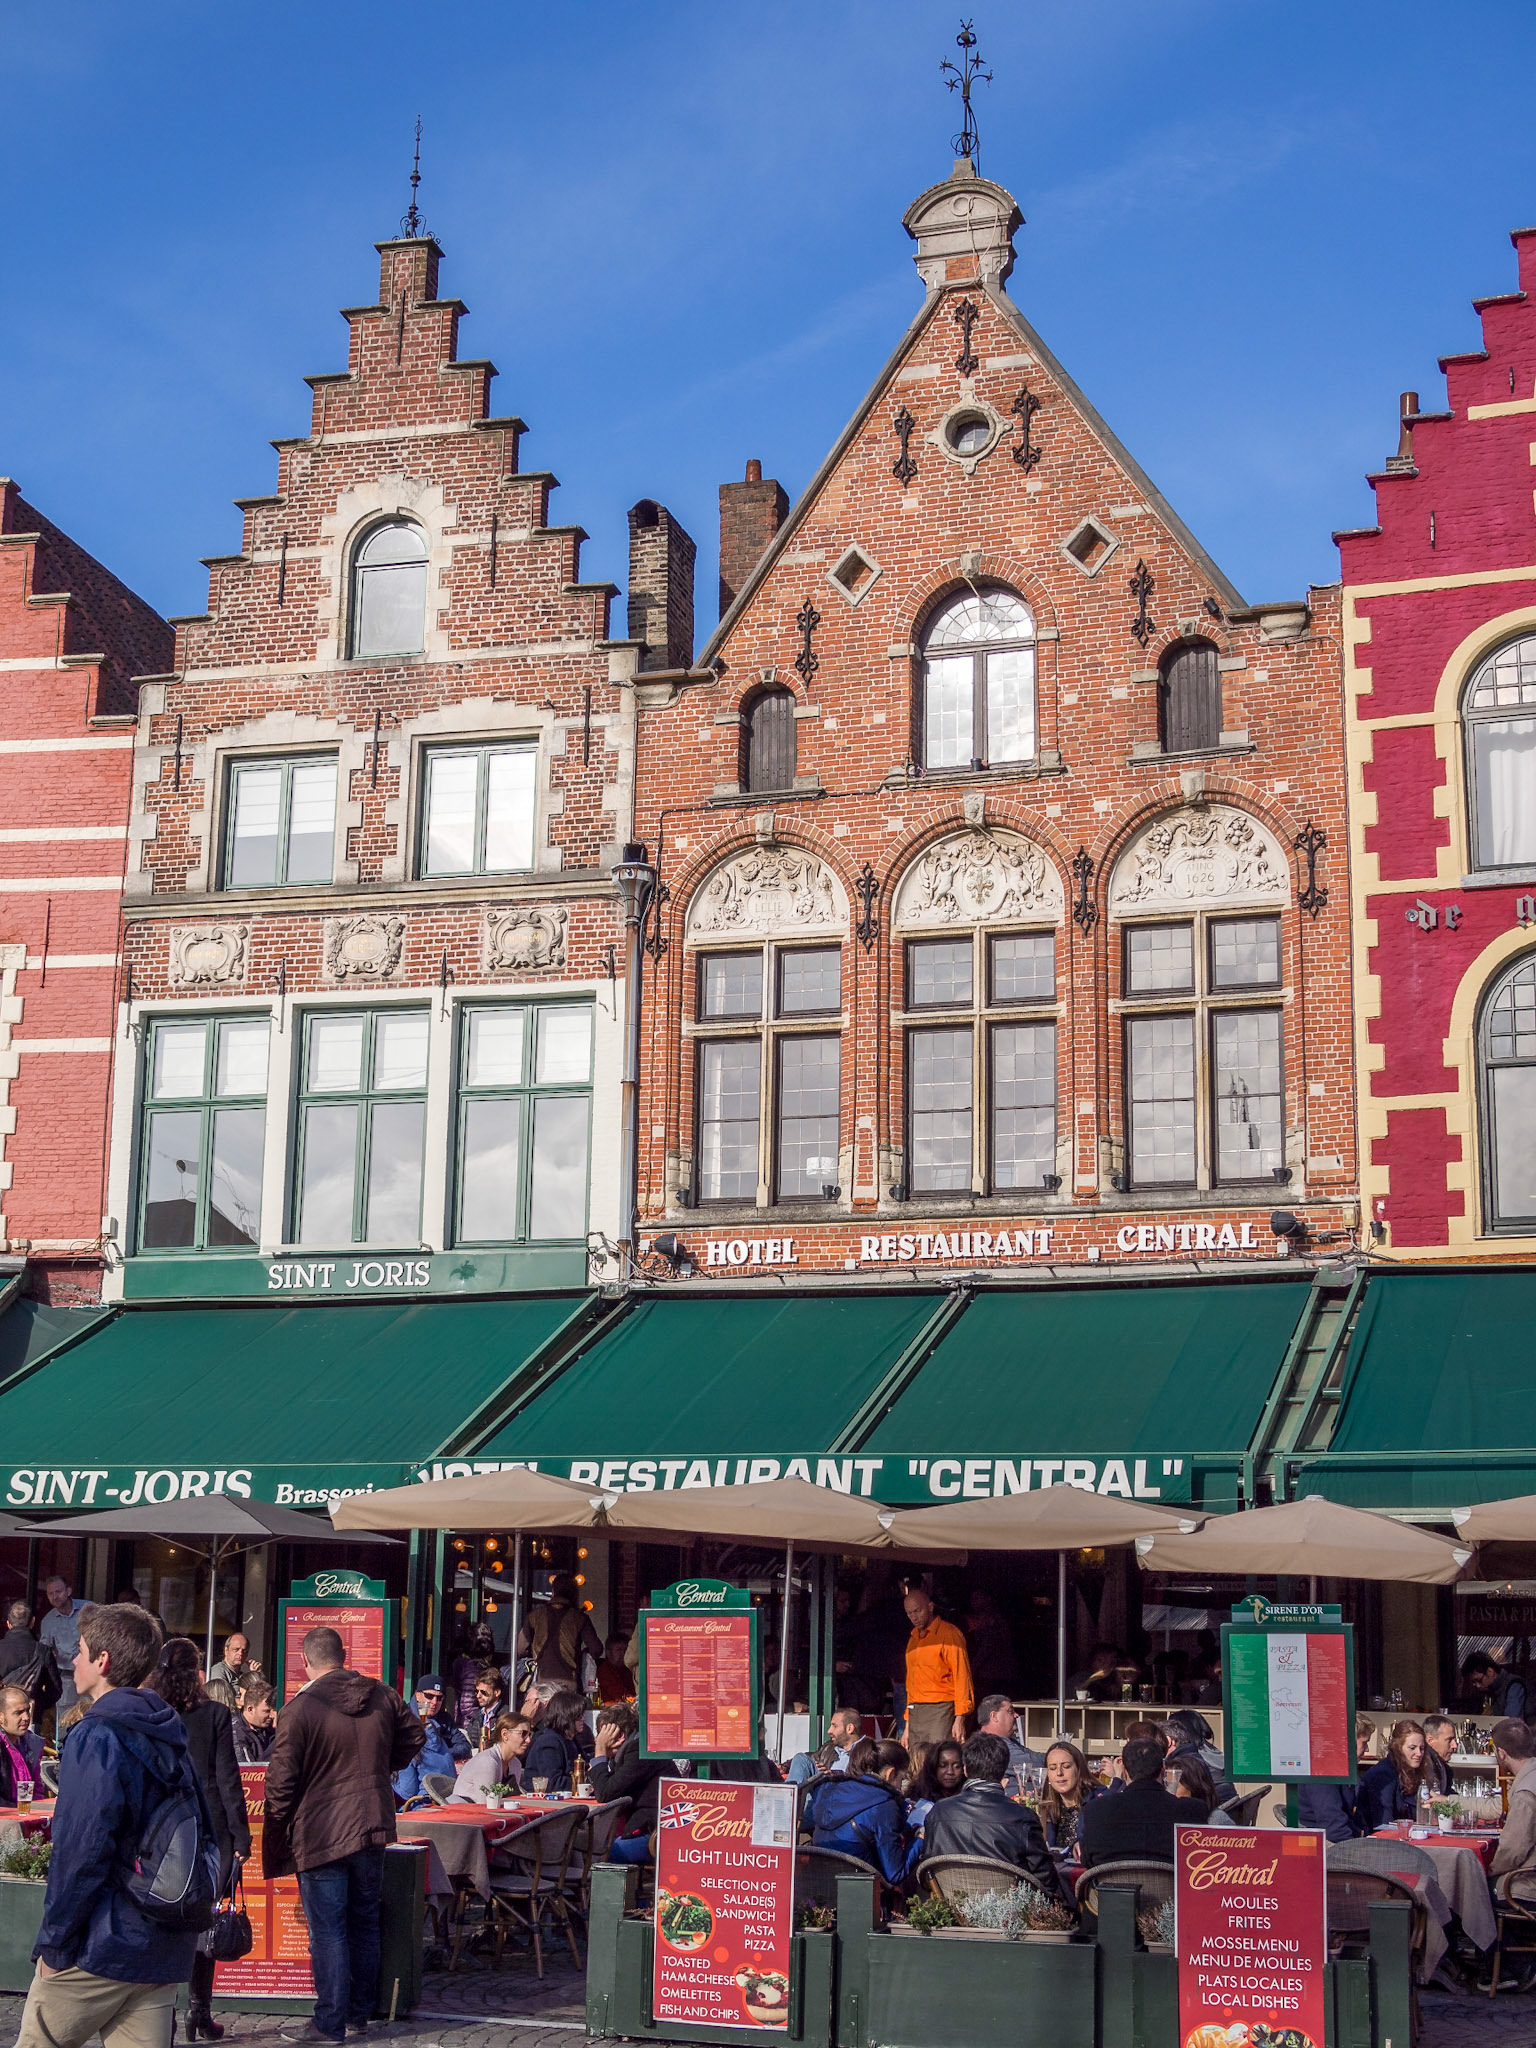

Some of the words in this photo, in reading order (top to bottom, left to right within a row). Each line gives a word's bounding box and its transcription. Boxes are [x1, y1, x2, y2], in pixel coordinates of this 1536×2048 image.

[1187, 872, 1215, 884] 1626
[755, 901, 784, 913] LELIE
[1416, 898, 1464, 931] de
[706, 1238, 799, 1266] HOTEL
[860, 1228, 1055, 1262] RESTAURANT
[1117, 1222, 1259, 1252] CENTRAL
[267, 1261, 337, 1290] SINT
[345, 1259, 431, 1288] JORIS
[569, 1458, 884, 1496] RESTAURANT
[909, 1459, 1183, 1498] "CENTRAL"
[6, 1469, 253, 1505] SINT-JORIS
[275, 1483, 386, 1504] Brasseri
[315, 1573, 364, 1598] Central
[676, 1582, 727, 1607] Central
[303, 1611, 340, 1622] Restaurant
[340, 1610, 367, 1624] Central
[1265, 1606, 1299, 1615] SIRENE
[1301, 1606, 1324, 1615] D'OR
[1470, 1606, 1506, 1621] PASTA
[1510, 1606, 1519, 1621] &
[1522, 1606, 1536, 1621] PI
[1273, 1615, 1316, 1623] restaurant
[664, 1622, 703, 1632] Restaurant
[704, 1620, 732, 1635] Central
[1270, 1645, 1298, 1653] PASTA
[1277, 1663, 1306, 1671] PIZZA
[240, 1771, 266, 1782] auran
[667, 1782, 738, 1802] Restaurant
[690, 1803, 753, 1842] Centr
[1180, 1829, 1258, 1849] Restaurant
[678, 1848, 723, 1864] LIGHT
[725, 1851, 779, 1869] LUNCH
[1185, 1849, 1279, 1890] Central
[700, 1877, 760, 1892] SELECTION
[760, 1881, 777, 1892] OF
[723, 1894, 777, 1908] SALADE(S)
[1220, 1896, 1279, 1911] MOULES
[715, 1907, 776, 1922] SANDWICH
[1228, 1915, 1271, 1930] FRITES
[743, 1924, 776, 1937] PASTA
[744, 1939, 775, 1952] PIZZA
[1201, 1936, 1299, 1953] MOSSELMENU
[662, 1955, 711, 1969] TOASTED
[1189, 1953, 1231, 1967] MENU
[1233, 1955, 1252, 1968] DE
[1254, 1956, 1312, 1971] MOULES
[661, 1970, 687, 1983] HAM
[1198, 1973, 1238, 1988] PLATS
[1240, 1976, 1303, 1991] LOCALES
[660, 1986, 721, 2002] OMELETTES
[1202, 1993, 1249, 2008] LOCAL
[1251, 1995, 1299, 2010] DISHES
[660, 2003, 683, 2016] FISH
[683, 2005, 708, 2018] AND
[709, 2006, 740, 2020] CHIPS
